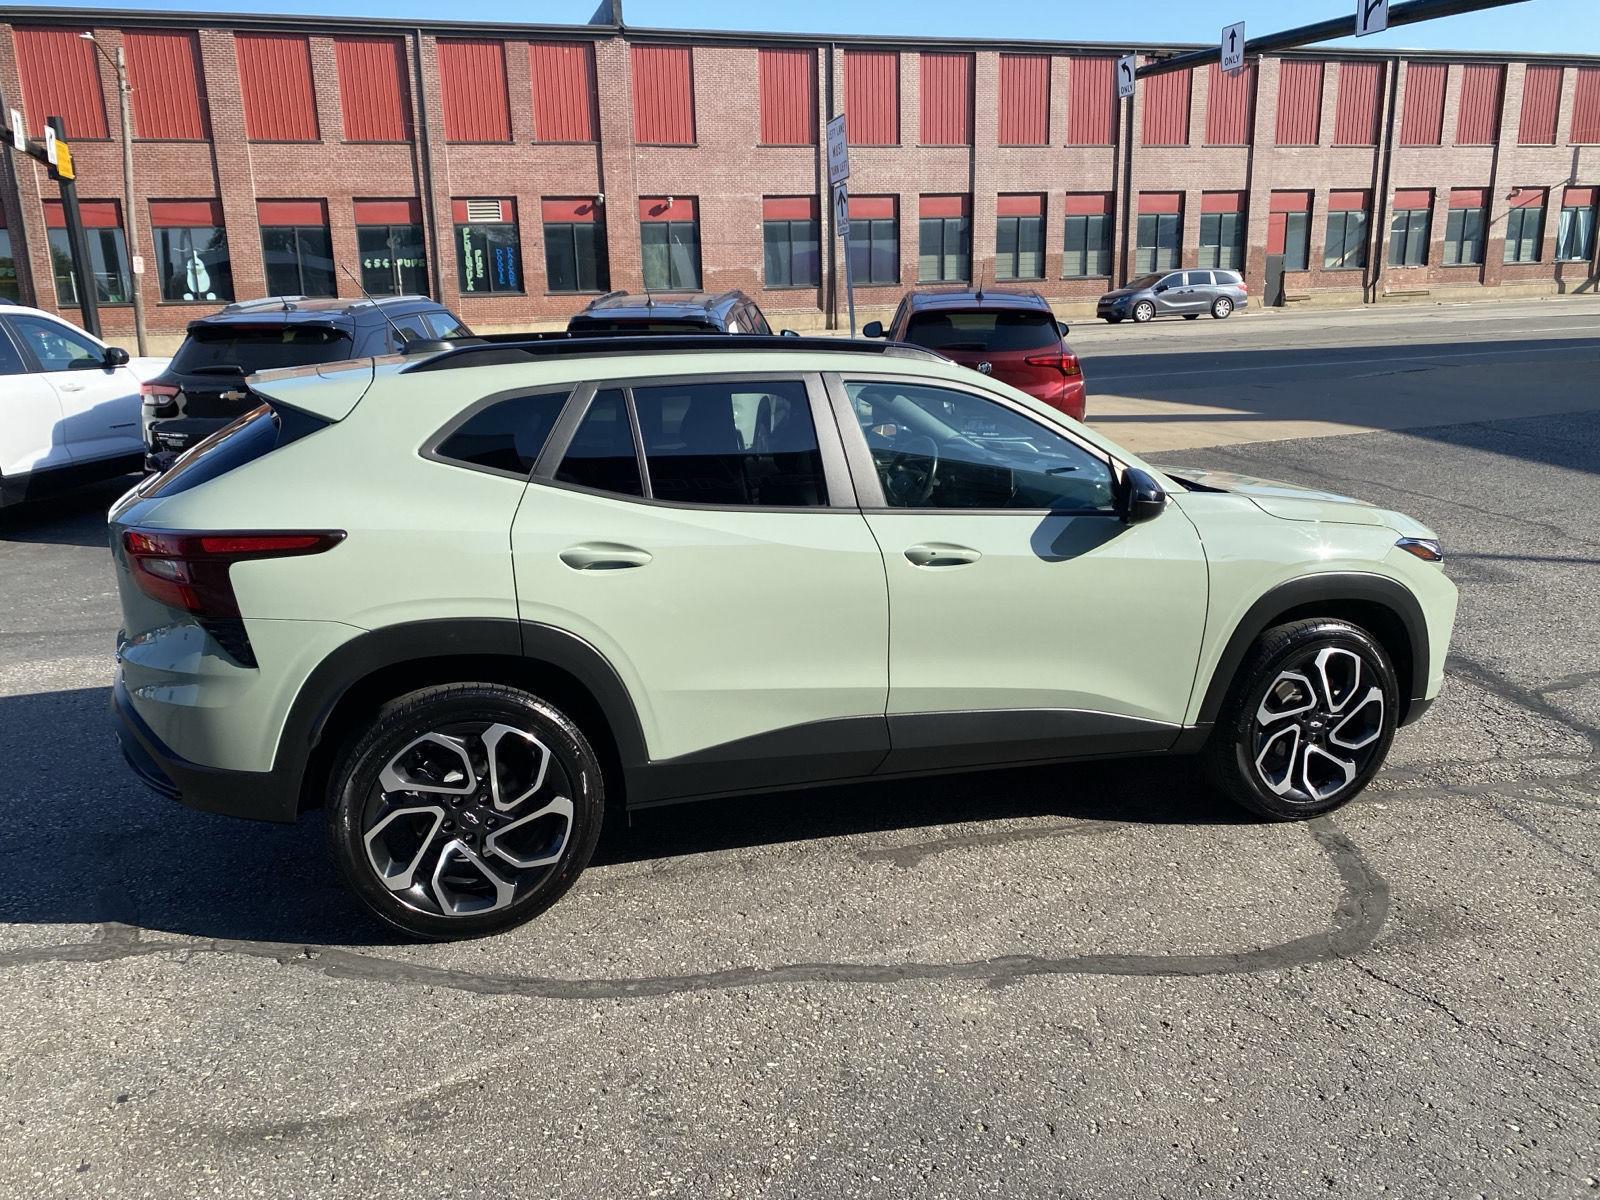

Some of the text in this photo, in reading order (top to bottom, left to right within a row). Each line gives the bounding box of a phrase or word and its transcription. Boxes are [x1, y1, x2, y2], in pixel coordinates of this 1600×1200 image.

[1224, 54, 1241, 67] ONLY
[1120, 84, 1133, 95] ONLY
[832, 141, 843, 158] MUST
[475, 249, 484, 279] PUPS
